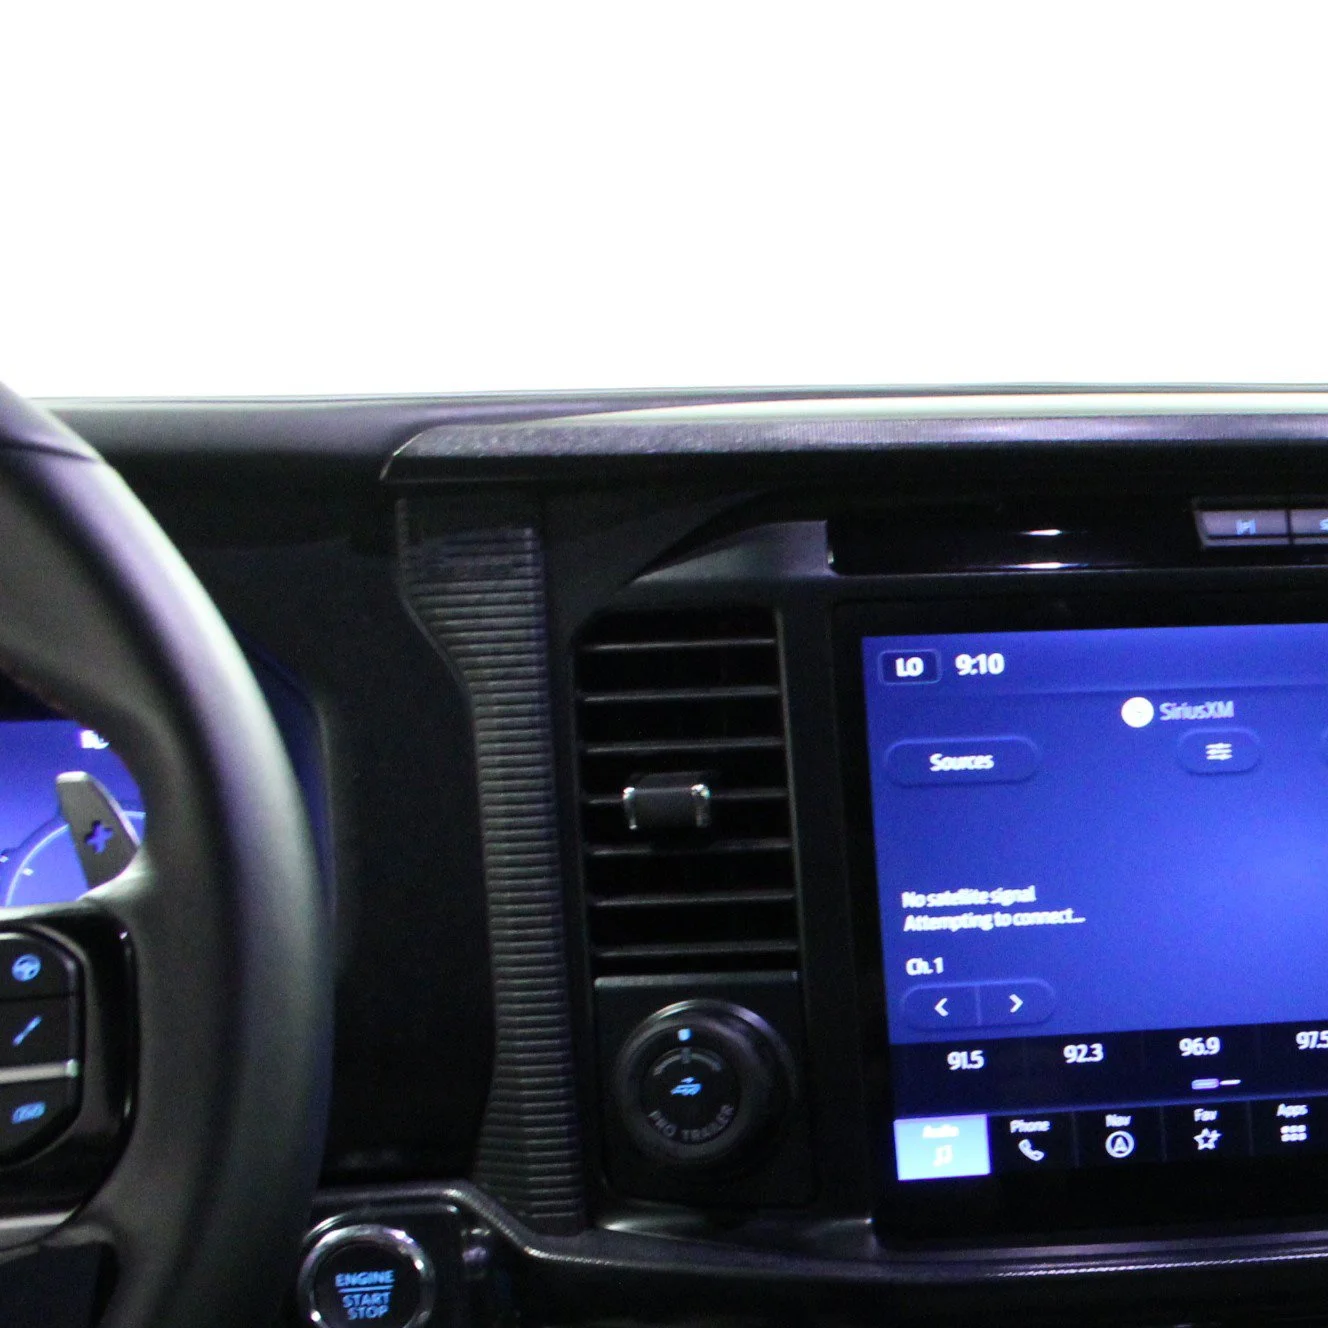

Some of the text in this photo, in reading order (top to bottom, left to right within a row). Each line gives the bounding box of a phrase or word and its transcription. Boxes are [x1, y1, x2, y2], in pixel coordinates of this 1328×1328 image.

[895, 657, 924, 678] LO
[955, 653, 1005, 676] 9:10
[1159, 700, 1234, 721] SiriusXM
[929, 753, 995, 772] Sources
[902, 885, 1037, 908] No satellite signal
[904, 912, 993, 932] Attempting
[994, 912, 1012, 927] to
[933, 957, 944, 974] 1
[1063, 1044, 1104, 1064] 92.3
[1179, 1036, 1221, 1056] 96.9
[947, 1050, 985, 1071] 91.5
[1193, 1108, 1218, 1123] Fav
[1276, 1102, 1308, 1118] Apps
[1010, 1118, 1050, 1134] Phone
[1105, 1113, 1131, 1127] Nav
[335, 1270, 395, 1287] ENGINE
[342, 1292, 391, 1308] START
[348, 1305, 389, 1320] STOP
